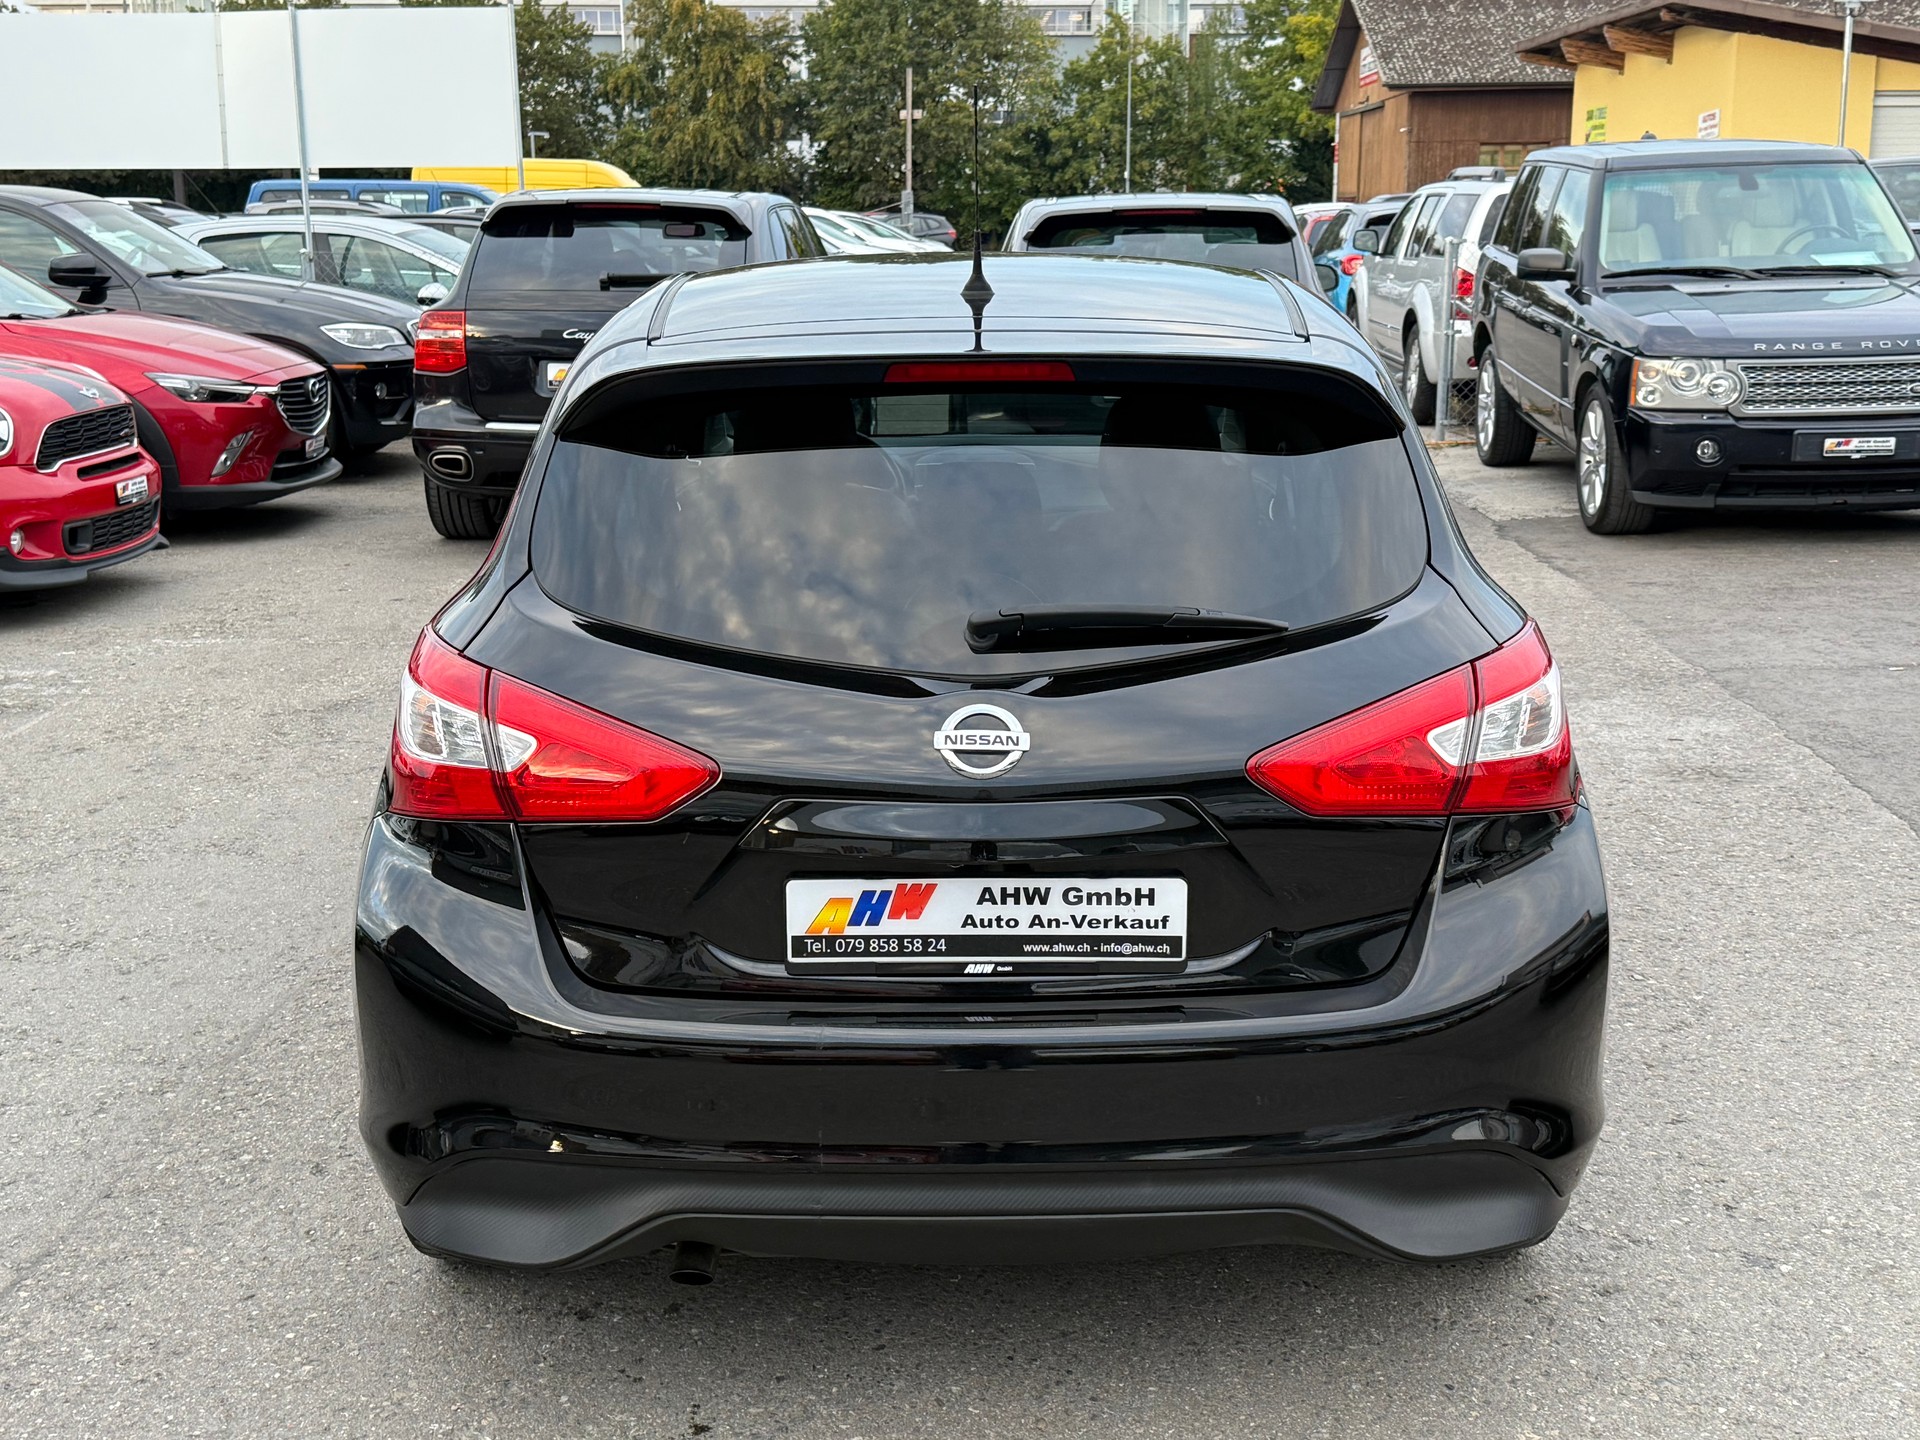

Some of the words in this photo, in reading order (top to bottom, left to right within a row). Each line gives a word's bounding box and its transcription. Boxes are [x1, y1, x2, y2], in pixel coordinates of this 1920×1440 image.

[1754, 342, 1842, 350] RANGE
[944, 734, 1020, 747] NISSAN
[976, 886, 1052, 906] AHW
[1061, 886, 1156, 907] GmbH
[805, 883, 938, 934] AHW
[960, 914, 1020, 929] Auto
[1028, 914, 1171, 930] An-Verkauf
[804, 938, 831, 953] Tel.
[835, 938, 865, 953] 079
[869, 938, 899, 953] 858
[903, 938, 923, 953] 58
[927, 938, 947, 953] 24
[1022, 942, 1091, 953] www.ahw.ch
[1100, 942, 1171, 955] info@ahw.ch
[963, 963, 996, 974] AHW
